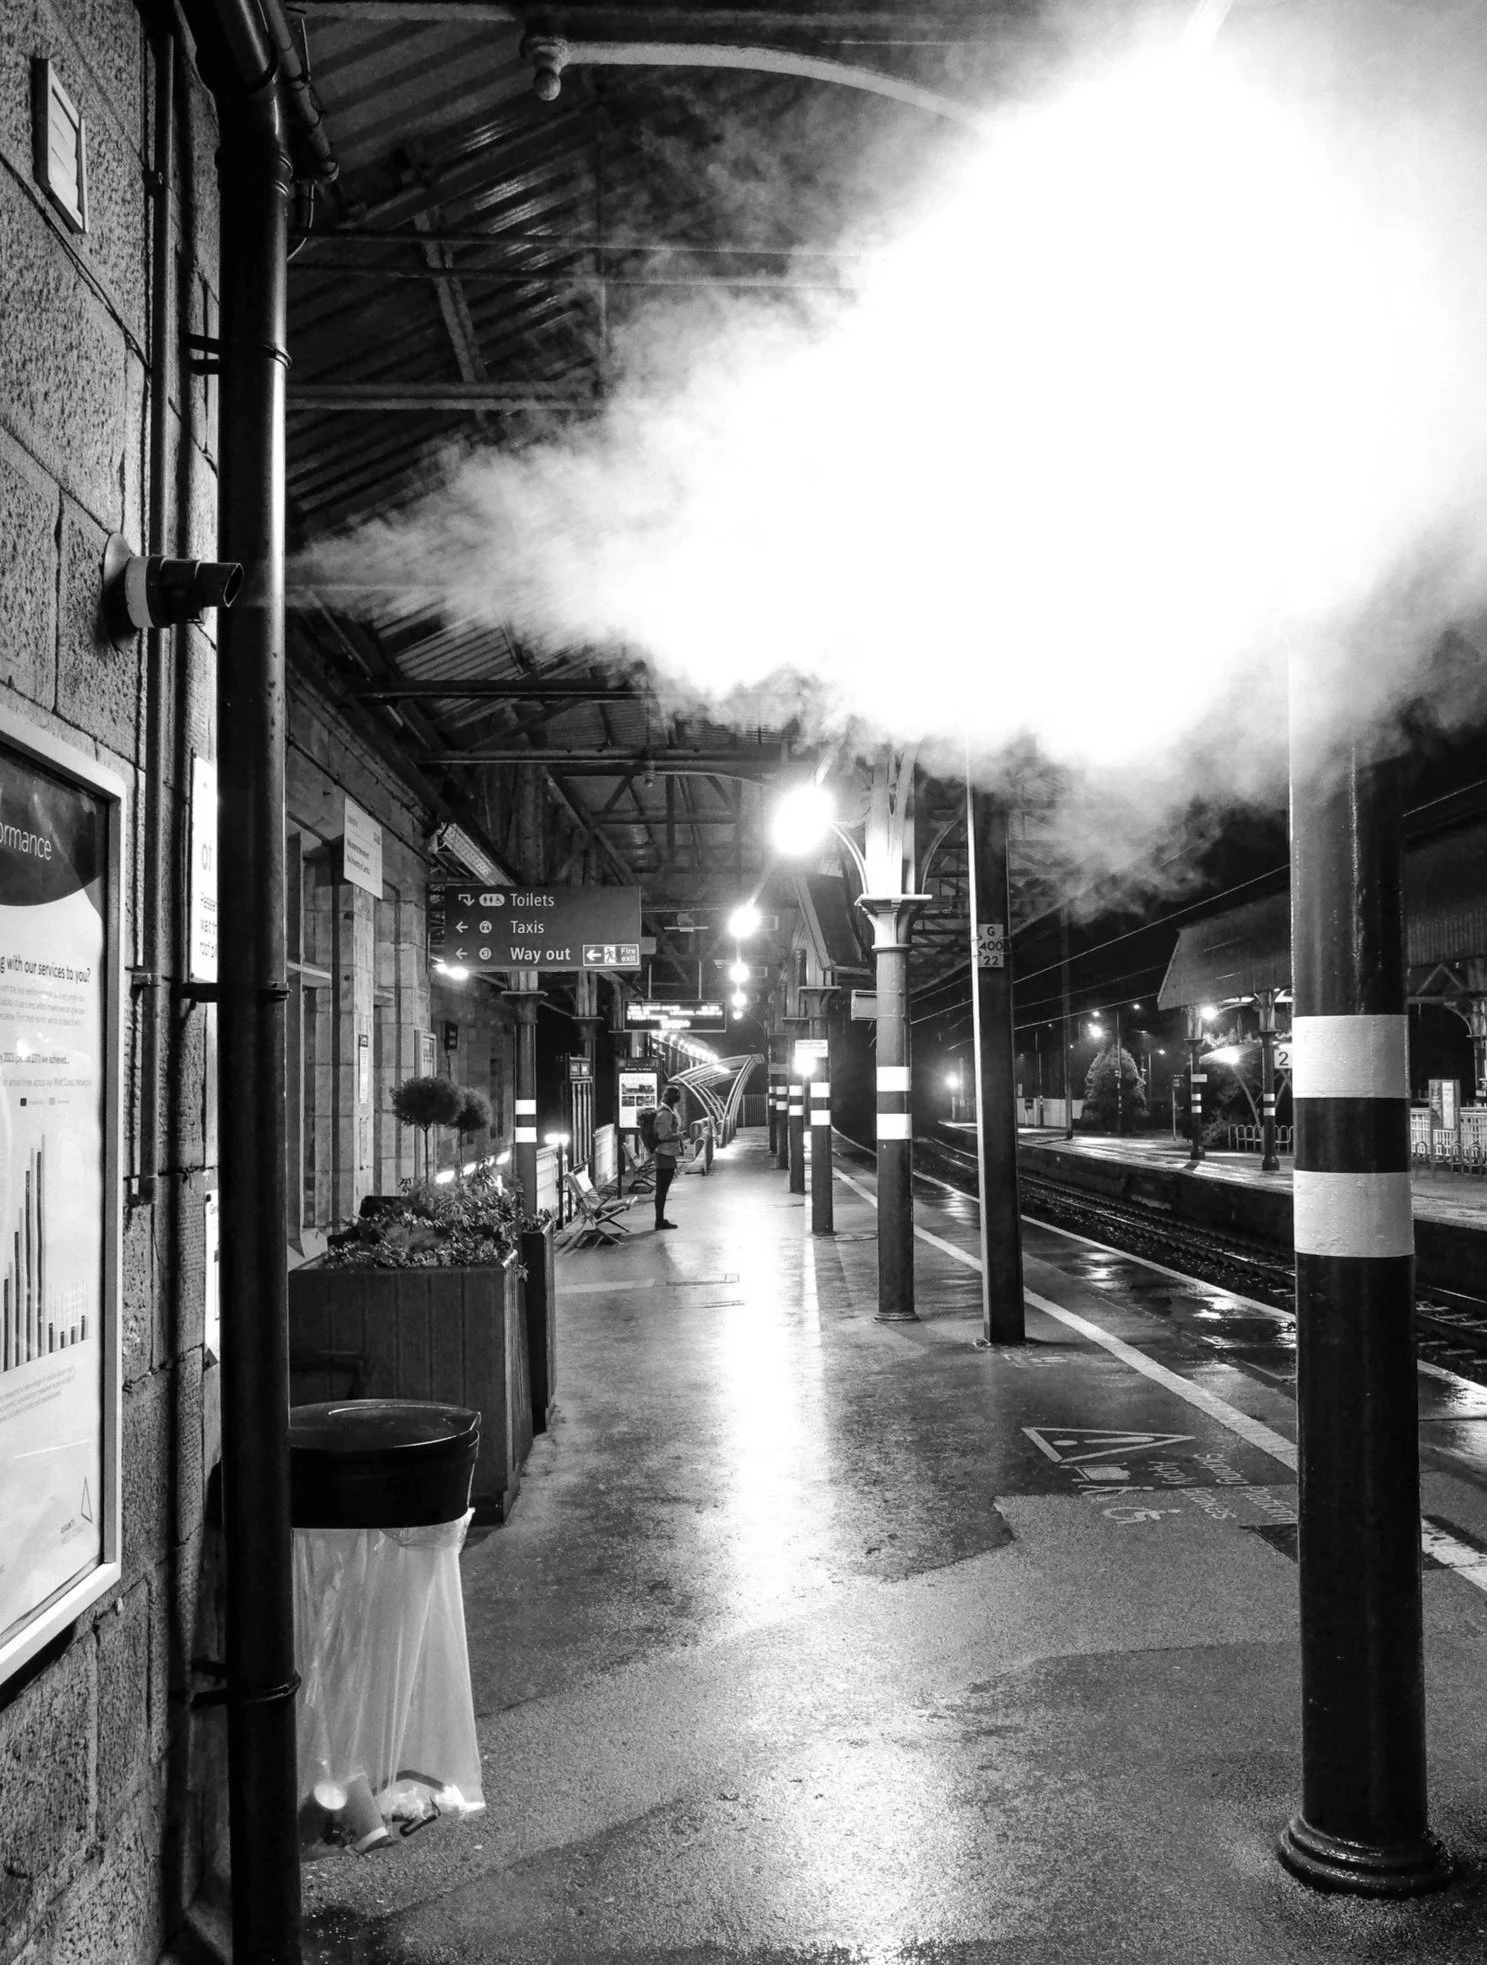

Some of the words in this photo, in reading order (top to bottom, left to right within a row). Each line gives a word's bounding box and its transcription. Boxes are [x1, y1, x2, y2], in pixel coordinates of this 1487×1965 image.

[510, 893, 555, 907] Toilets
[510, 920, 545, 934] Taxis
[987, 926, 995, 936] G
[620, 947, 637, 955] Fire
[980, 941, 1003, 951] 400
[510, 947, 541, 964] Way
[546, 948, 571, 960] out
[620, 954, 637, 962] exit
[984, 956, 999, 966] 22
[7, 954, 23, 972] with
[24, 961, 37, 975] our
[38, 961, 65, 979] services
[66, 966, 74, 980] to
[75, 967, 91, 985] you?
[1278, 1051, 1289, 1066] 2
[1193, 1453, 1249, 1485] Sloping
[1147, 1461, 1198, 1485] Apply
[1178, 1487, 1237, 1520] Brakes
